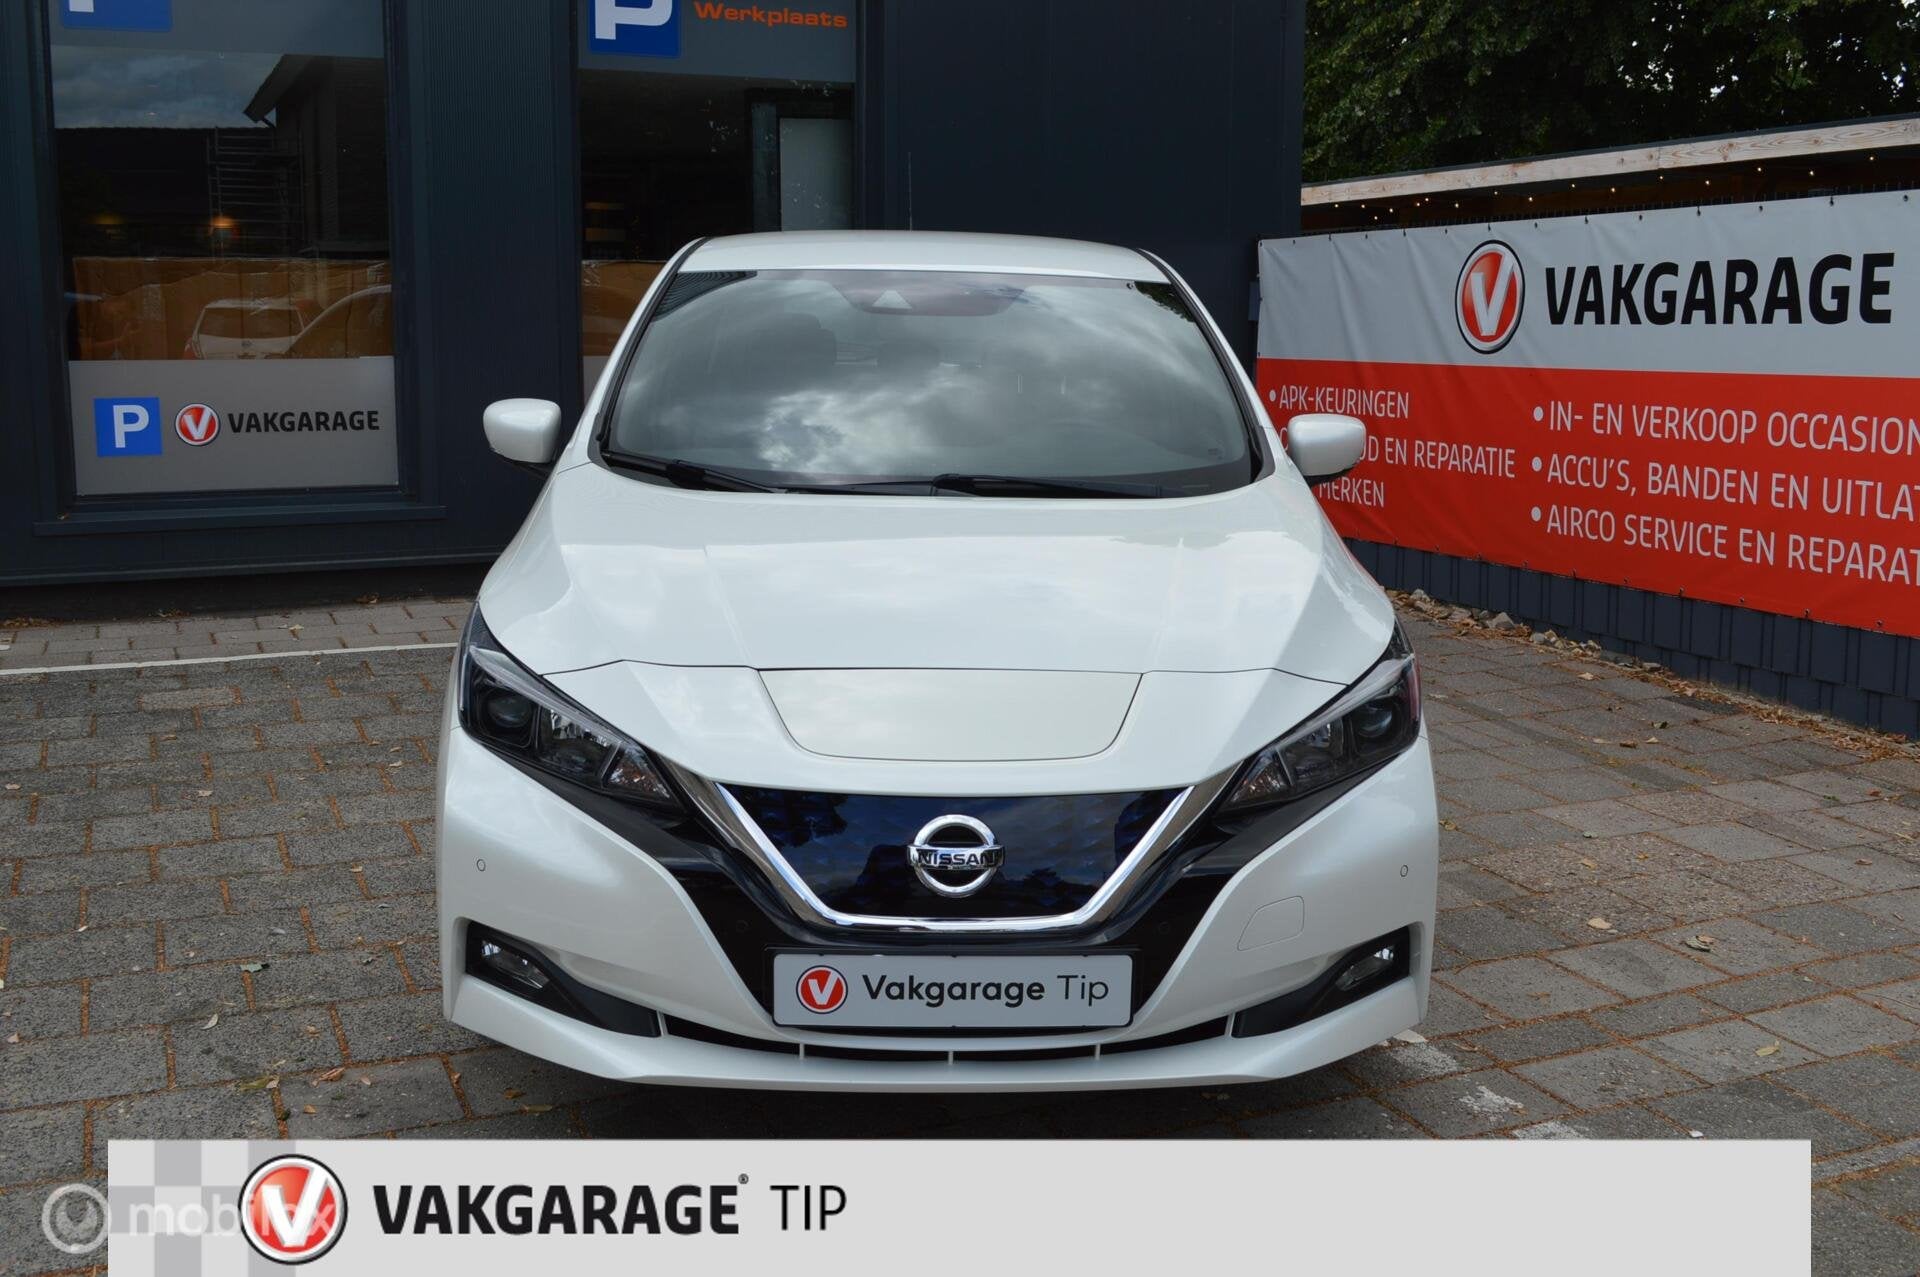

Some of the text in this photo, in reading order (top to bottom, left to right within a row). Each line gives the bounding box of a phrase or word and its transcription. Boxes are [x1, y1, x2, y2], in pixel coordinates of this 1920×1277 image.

[694, 0, 848, 28] Werkplaats
[1545, 252, 1895, 326] VAKGARAGE
[1279, 384, 1409, 419] APK-KEURINGEN
[228, 410, 380, 433] VAKGARAGE
[1549, 400, 1583, 432] IN-
[1593, 402, 1623, 435] EN
[1632, 404, 1757, 444] VERKOOP
[1385, 437, 1407, 465] EN
[1414, 440, 1516, 478] REPARATIE
[1319, 476, 1385, 507] MERKEN
[1547, 453, 1637, 497] ACCU'S,
[1647, 462, 1758, 505] BANDEN
[1771, 473, 1809, 511] EN
[1547, 504, 1616, 542] AIRCO
[1624, 514, 1728, 560] SERVICE
[1739, 527, 1775, 566] EN
[917, 848, 995, 867] NISSAN
[862, 974, 1045, 1009] Vakgarage
[1056, 974, 1109, 1007] Tip
